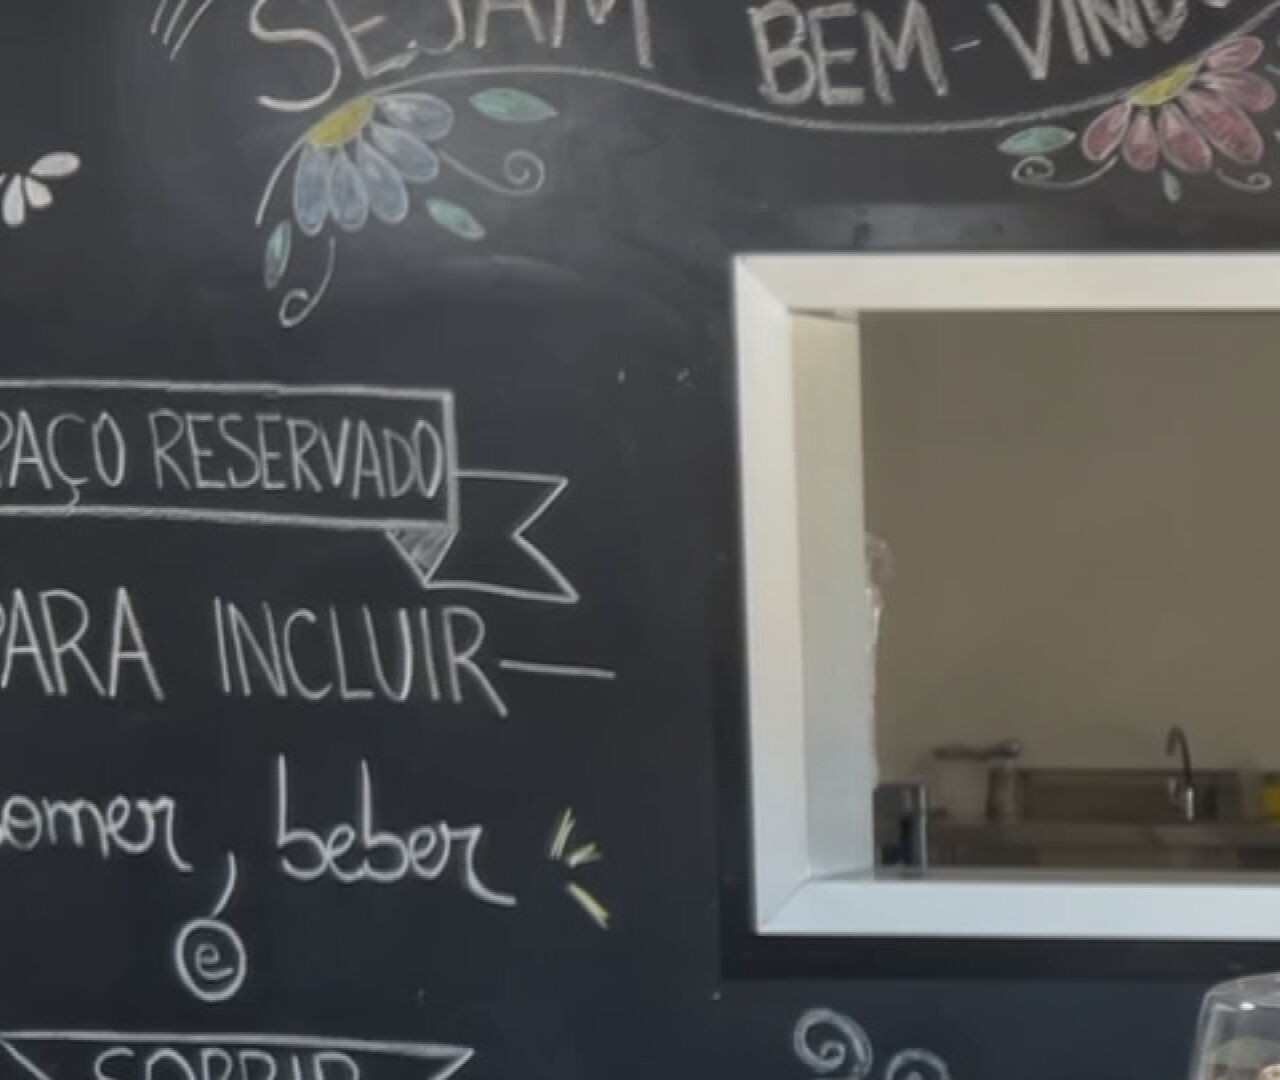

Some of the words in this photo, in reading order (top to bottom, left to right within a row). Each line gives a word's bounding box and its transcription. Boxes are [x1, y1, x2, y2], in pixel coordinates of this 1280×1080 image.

[746, 0, 1230, 105] BEM-VIND
[148, 408, 442, 499] RESERVADO
[0, 586, 164, 700] ARA
[213, 596, 508, 715] INCLUIR
[276, 754, 517, 906] beber
